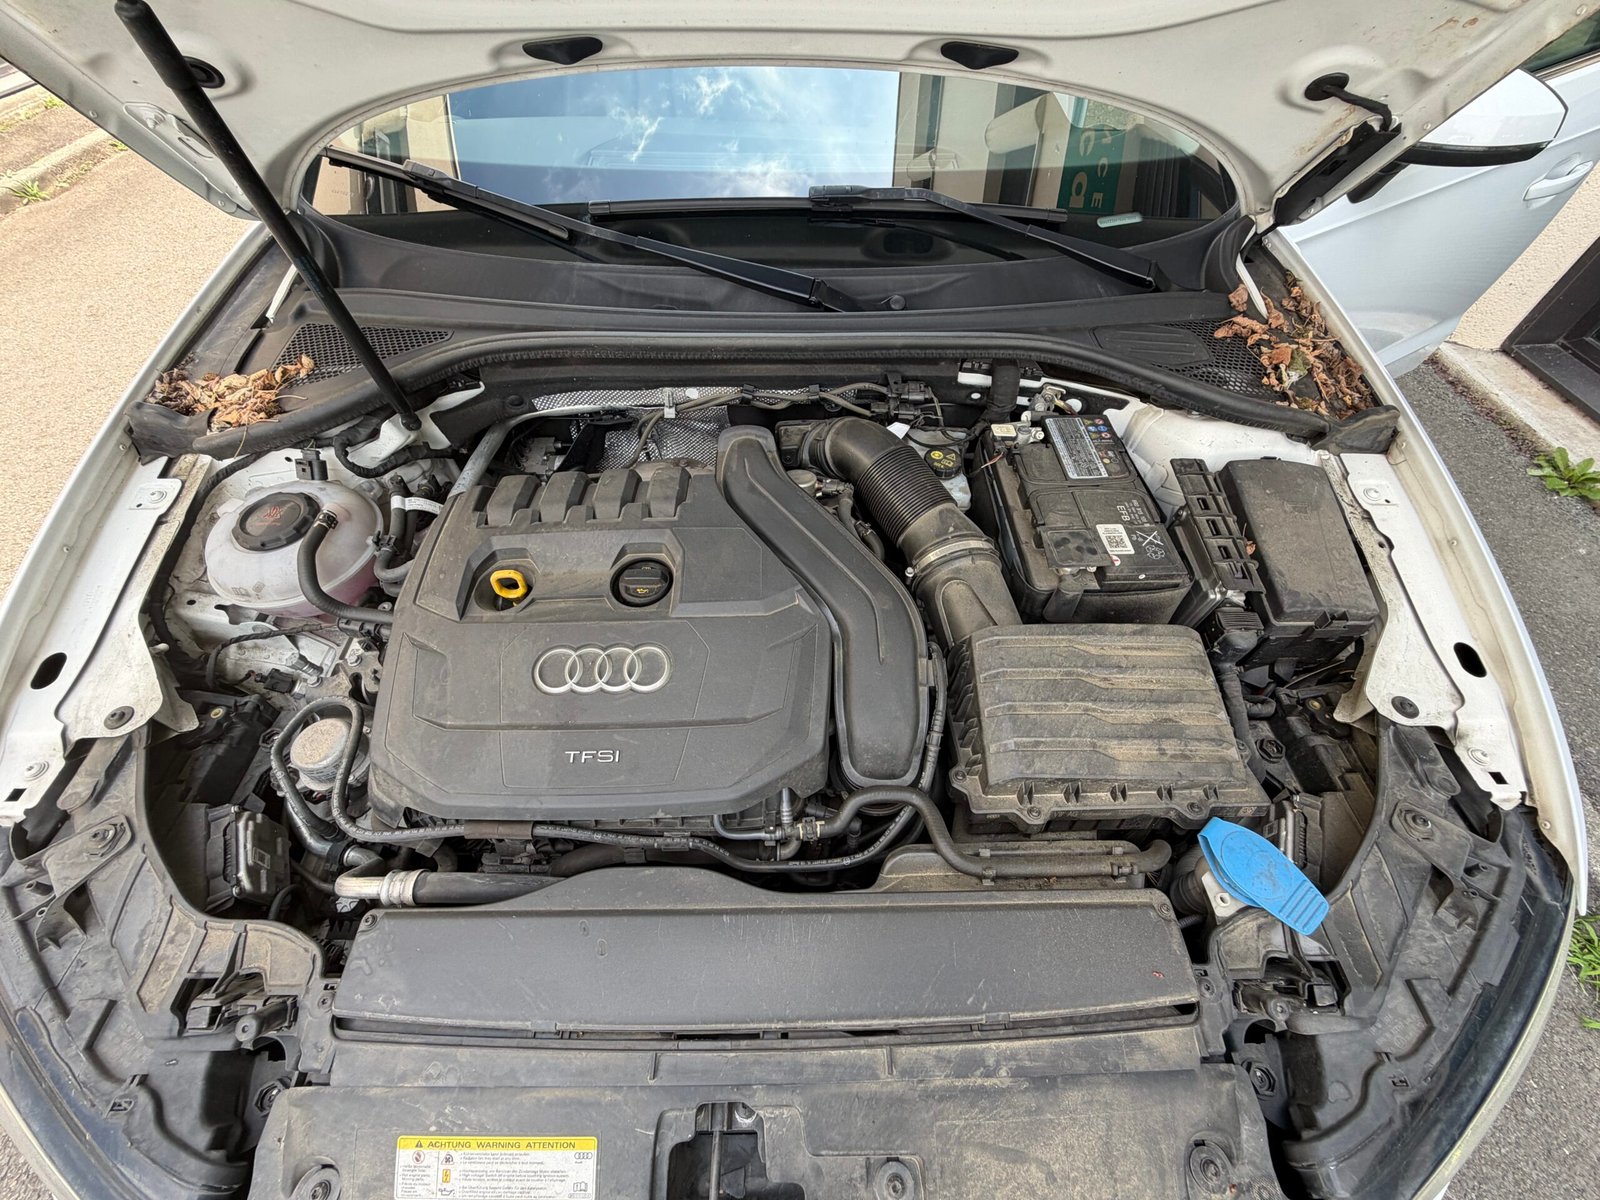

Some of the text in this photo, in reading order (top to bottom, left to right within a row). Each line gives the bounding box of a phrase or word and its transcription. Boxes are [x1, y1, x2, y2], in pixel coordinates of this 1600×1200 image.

[1116, 505, 1131, 522] EFB
[564, 750, 620, 763] TFSI
[427, 1141, 576, 1149] ACHTUNG WARNING ATTENTION
